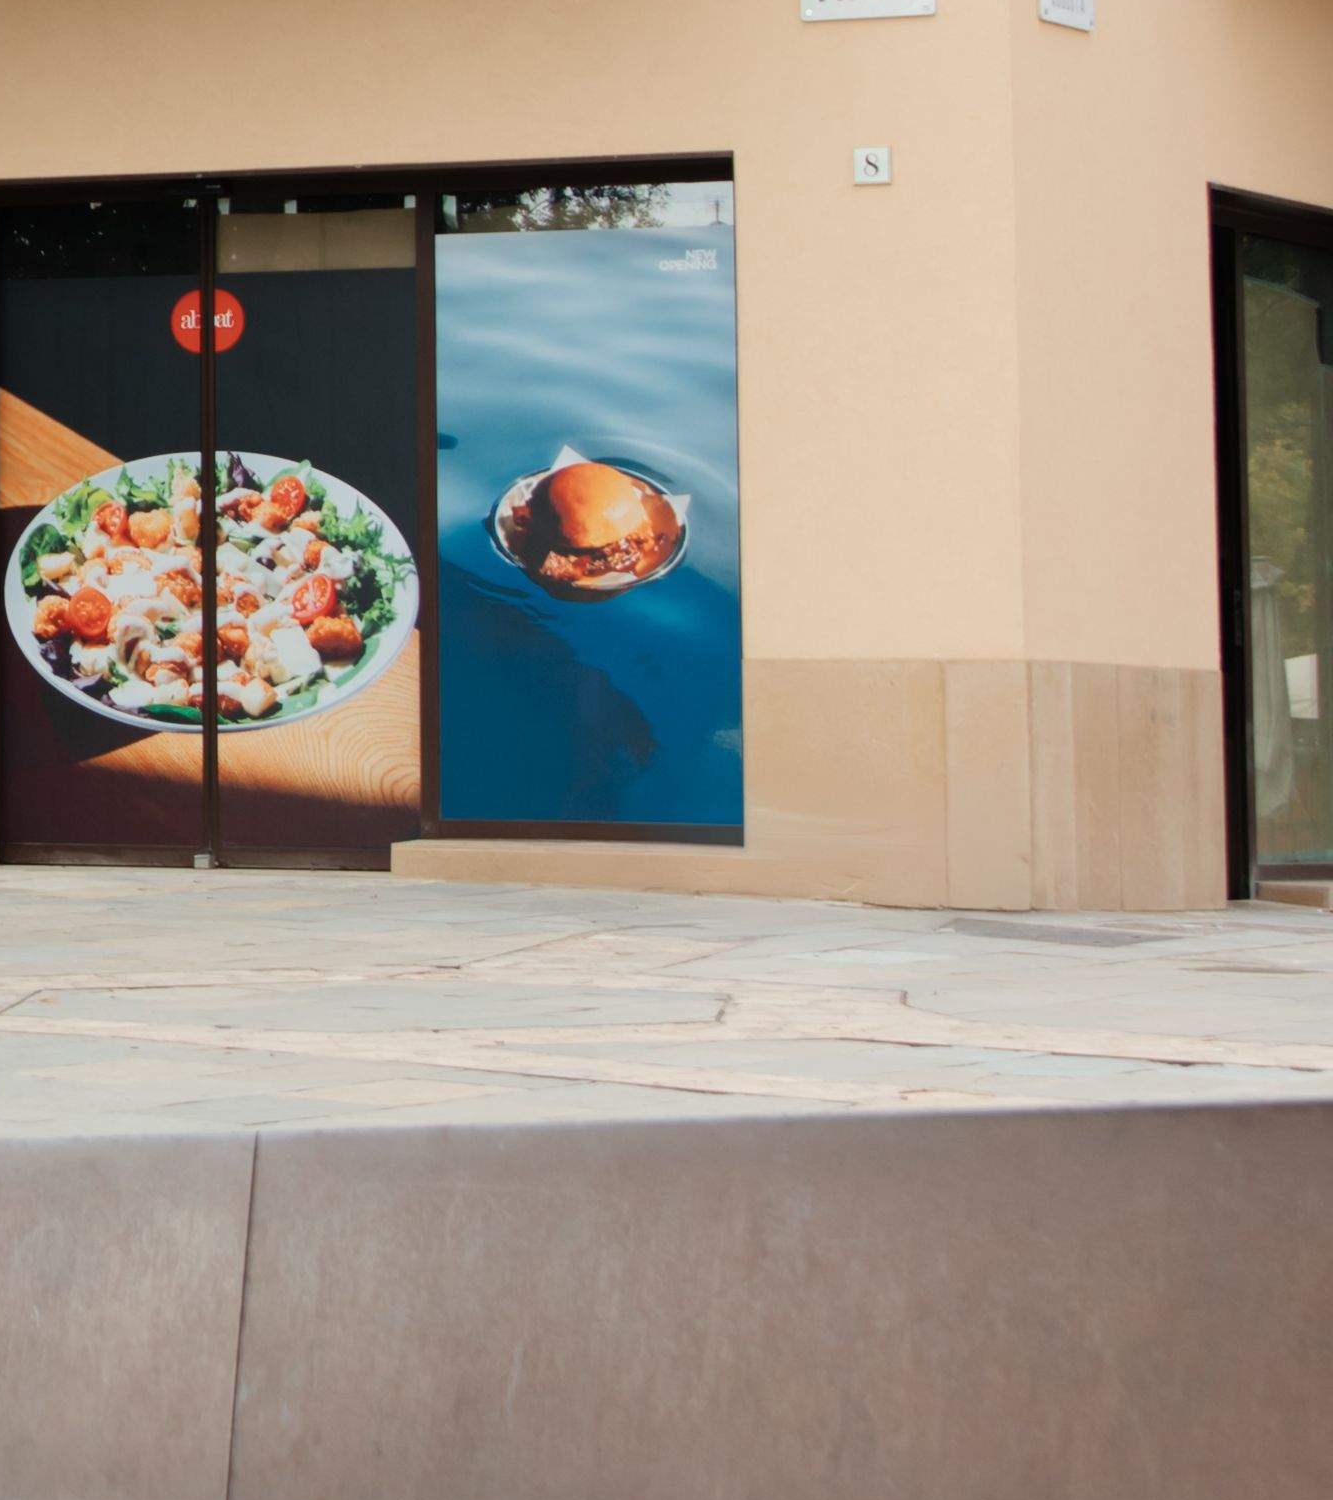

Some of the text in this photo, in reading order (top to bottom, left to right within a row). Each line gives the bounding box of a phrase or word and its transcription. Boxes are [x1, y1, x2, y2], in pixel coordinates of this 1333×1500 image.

[863, 152, 880, 177] 8
[686, 249, 717, 260] NEW
[659, 260, 717, 271] OPENING
